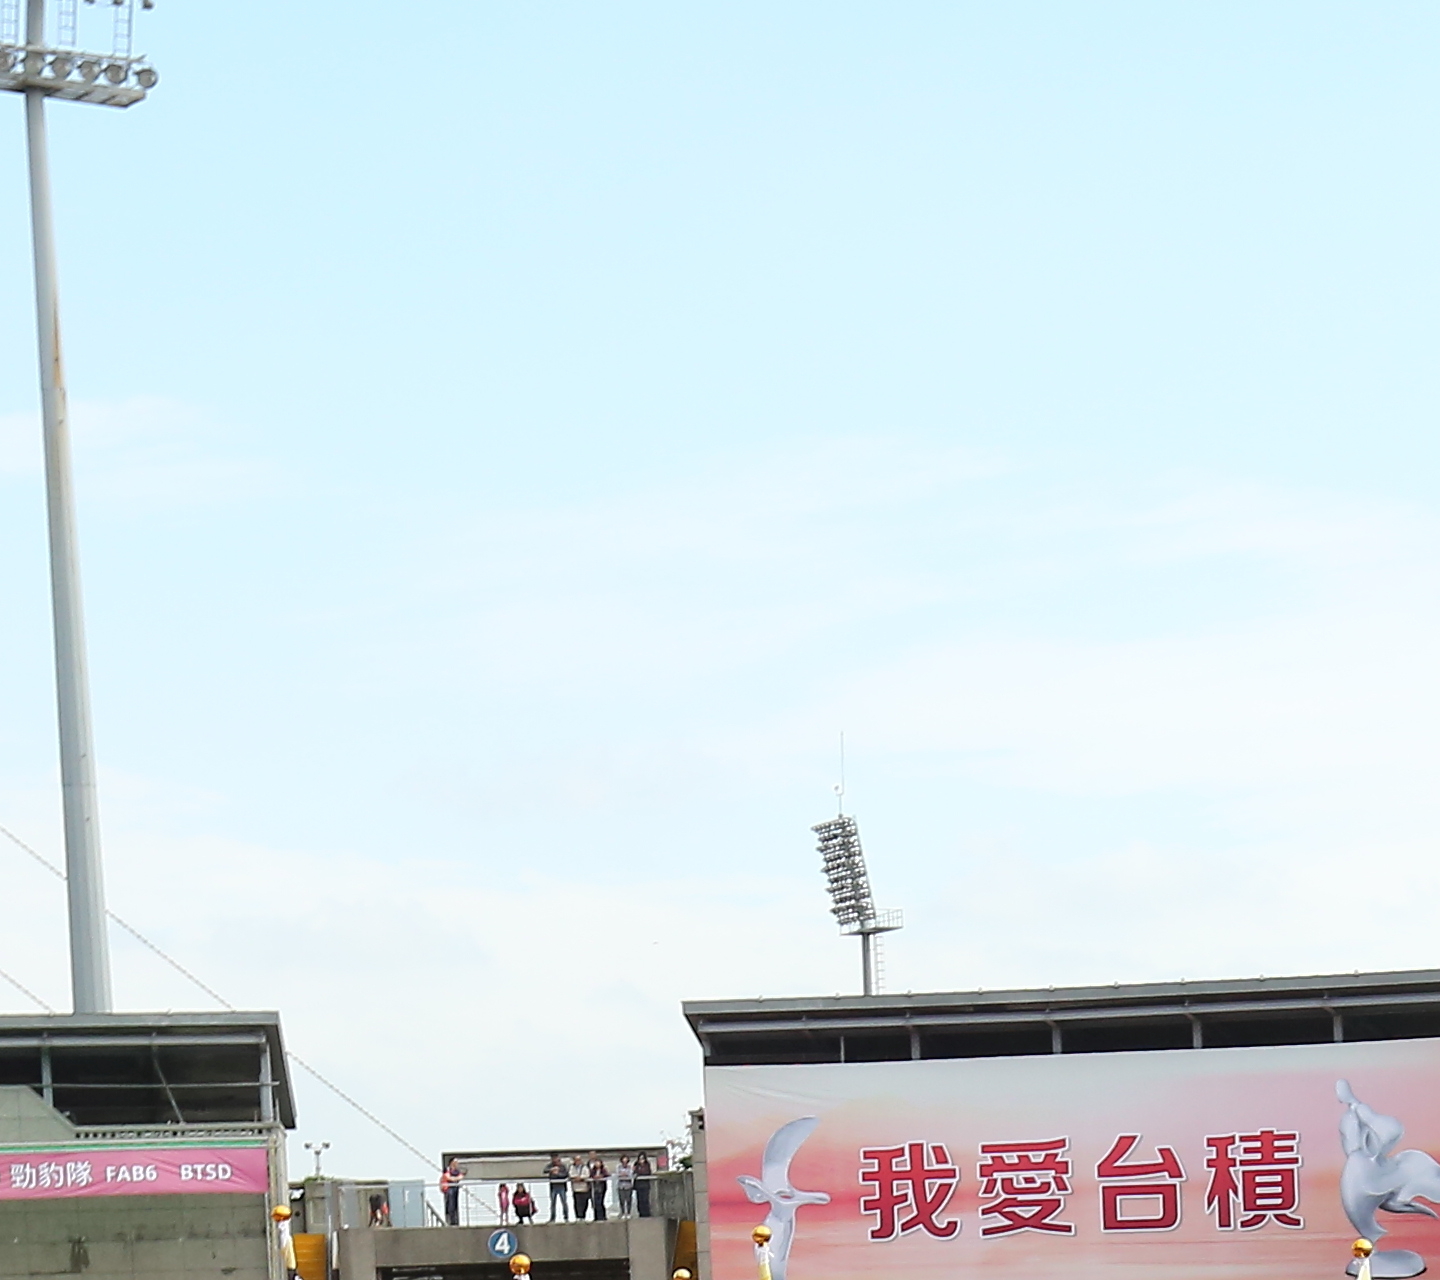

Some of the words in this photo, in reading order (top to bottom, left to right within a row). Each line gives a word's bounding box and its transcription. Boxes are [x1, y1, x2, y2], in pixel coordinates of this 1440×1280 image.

[9, 1160, 93, 1189] 勁豹隊
[105, 1164, 158, 1183] FAB6
[180, 1163, 232, 1181] BTSD
[860, 1127, 1305, 1242] 我愛台積
[494, 1232, 510, 1255] 4
